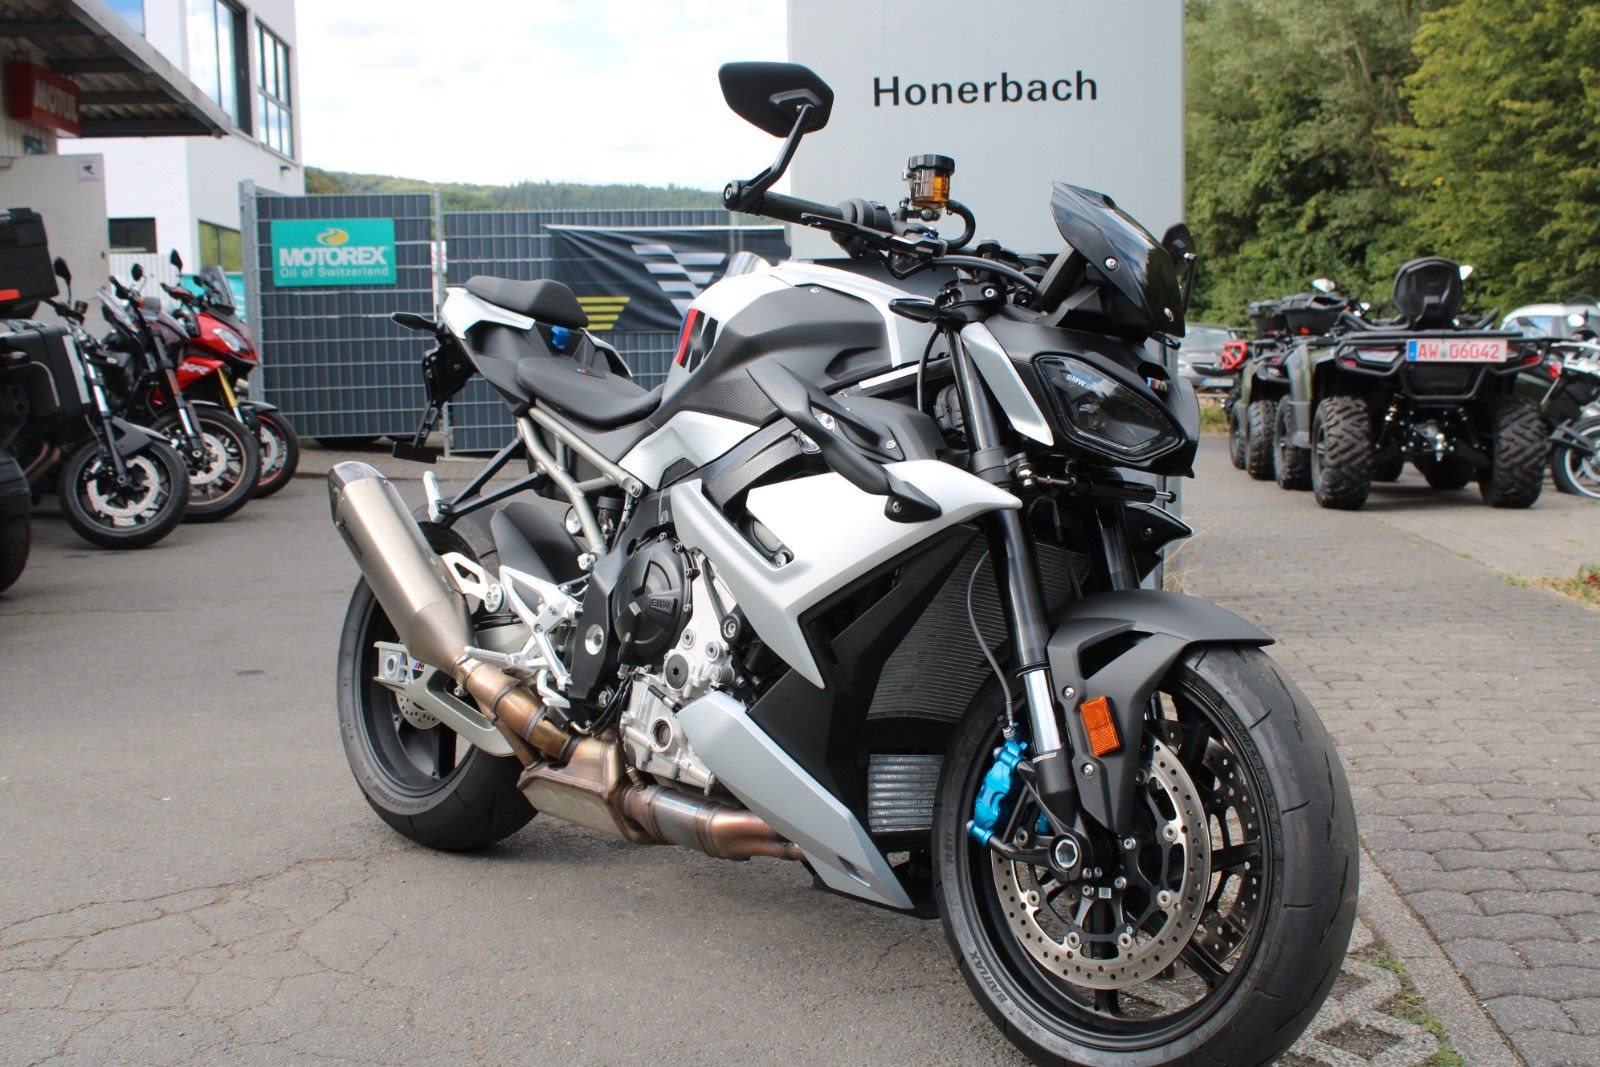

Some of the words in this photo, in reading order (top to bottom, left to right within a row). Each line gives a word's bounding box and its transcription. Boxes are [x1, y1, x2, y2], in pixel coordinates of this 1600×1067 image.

[874, 70, 1097, 106] Honerbach
[33, 79, 79, 122] MOTUL
[279, 246, 388, 267] MOTOREX
[280, 267, 297, 278] Oil
[301, 266, 313, 277] of
[318, 265, 389, 277] Switzerland
[1418, 343, 1439, 359] AW
[1449, 343, 1500, 359] 06042
[1066, 374, 1086, 387] BMW
[969, 950, 1009, 1004] BATTLAX
